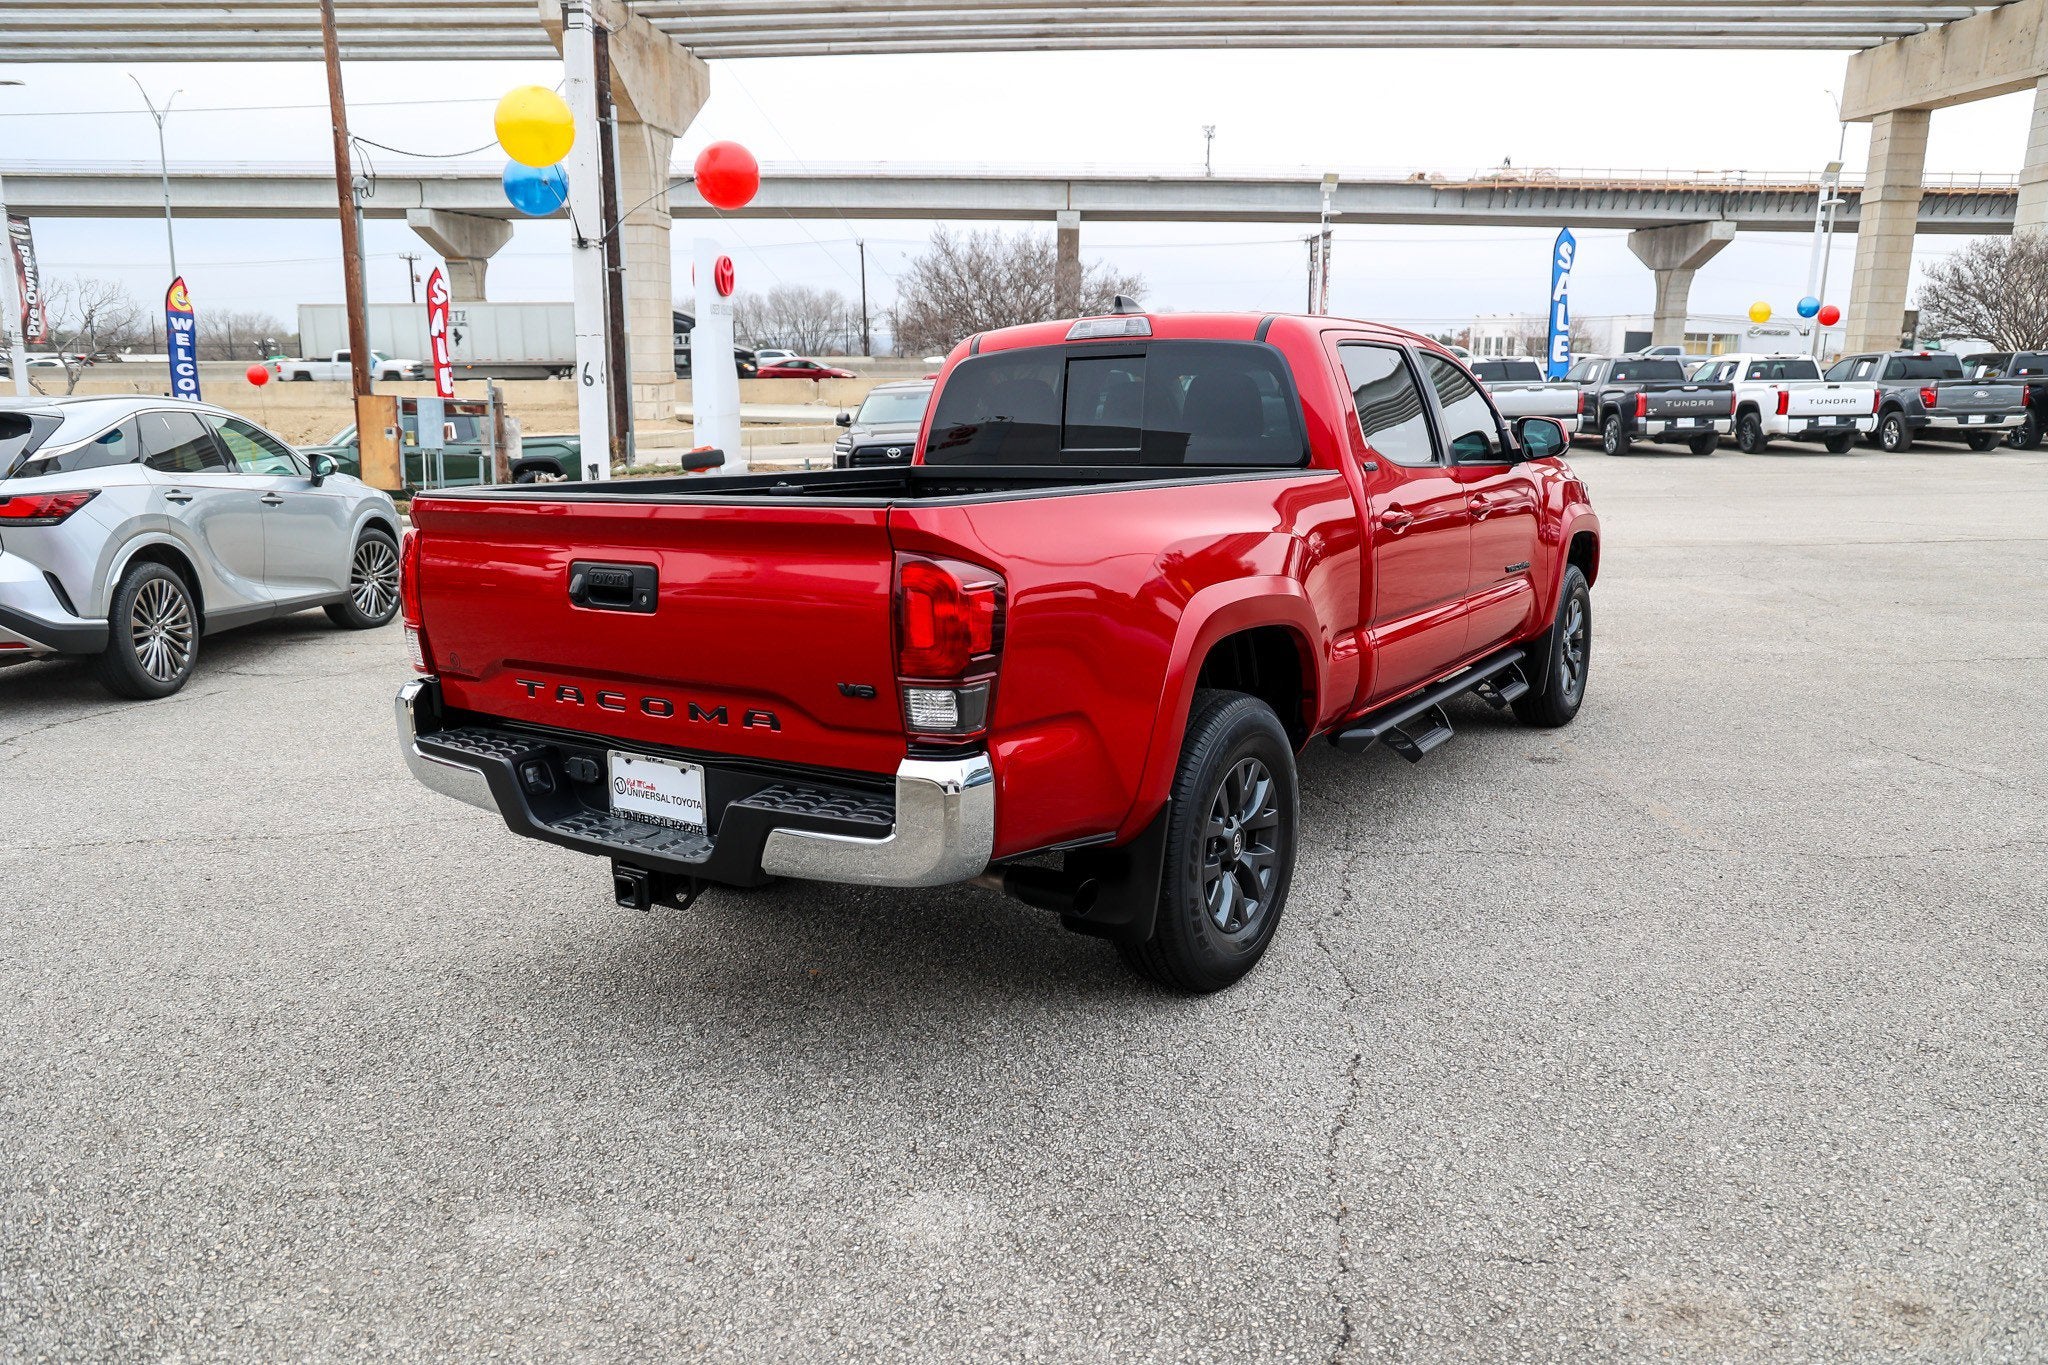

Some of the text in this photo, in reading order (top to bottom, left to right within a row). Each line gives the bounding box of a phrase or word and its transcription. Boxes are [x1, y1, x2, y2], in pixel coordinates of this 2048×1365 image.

[17, 244, 38, 304] Owned
[1552, 241, 1573, 363] SALE
[27, 307, 40, 337] Pre
[582, 361, 594, 387] 6
[837, 682, 874, 697] V6
[515, 678, 782, 734] TACOMA
[626, 787, 702, 810] UNIVERSAL TOYOTA
[621, 810, 670, 828] UNIVERSAL
